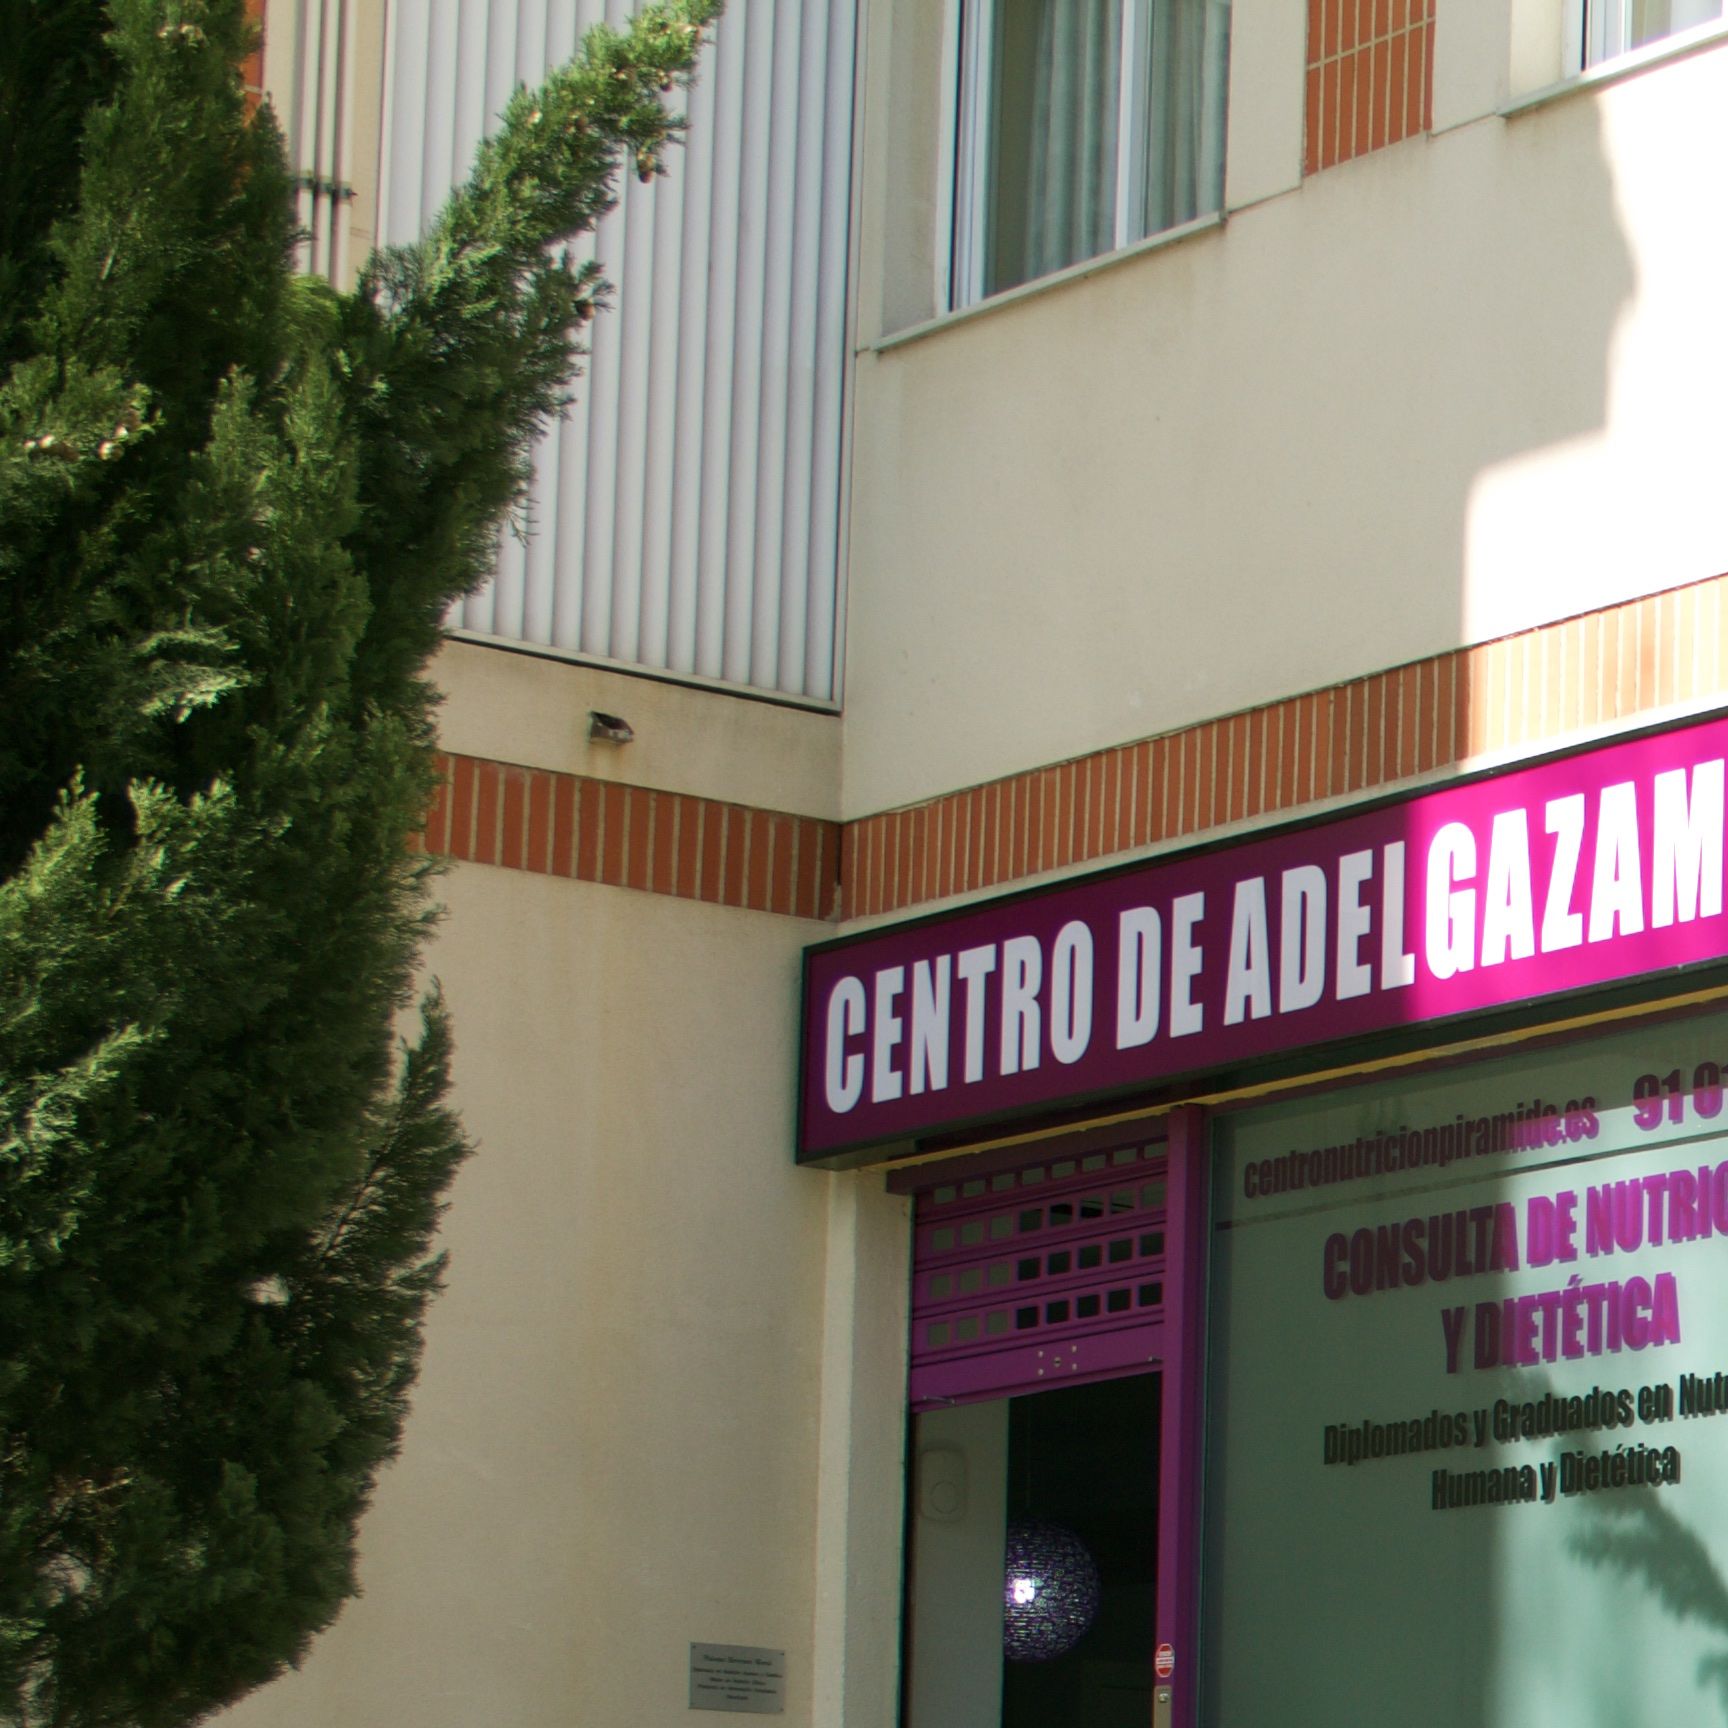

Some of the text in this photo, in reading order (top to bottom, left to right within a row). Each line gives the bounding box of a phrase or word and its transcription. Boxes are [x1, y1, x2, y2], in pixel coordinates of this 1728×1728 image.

[824, 919, 1094, 1114] CENTRO
[1115, 890, 1205, 1050] DE
[1244, 1096, 1600, 1199] centronutricionpiramide.es
[1632, 1069, 1684, 1131] 91
[1323, 1202, 1519, 1300] CONSULTA
[1526, 1190, 1578, 1268] DE
[1441, 1271, 1681, 1374] Y DIETÉTICA
[1323, 1410, 1468, 1467] Diplomados
[1473, 1407, 1488, 1448] y
[1493, 1386, 1635, 1443] Graduados
[1638, 1382, 1675, 1423] en
[1431, 1444, 1681, 1510] Humana y Dietética
